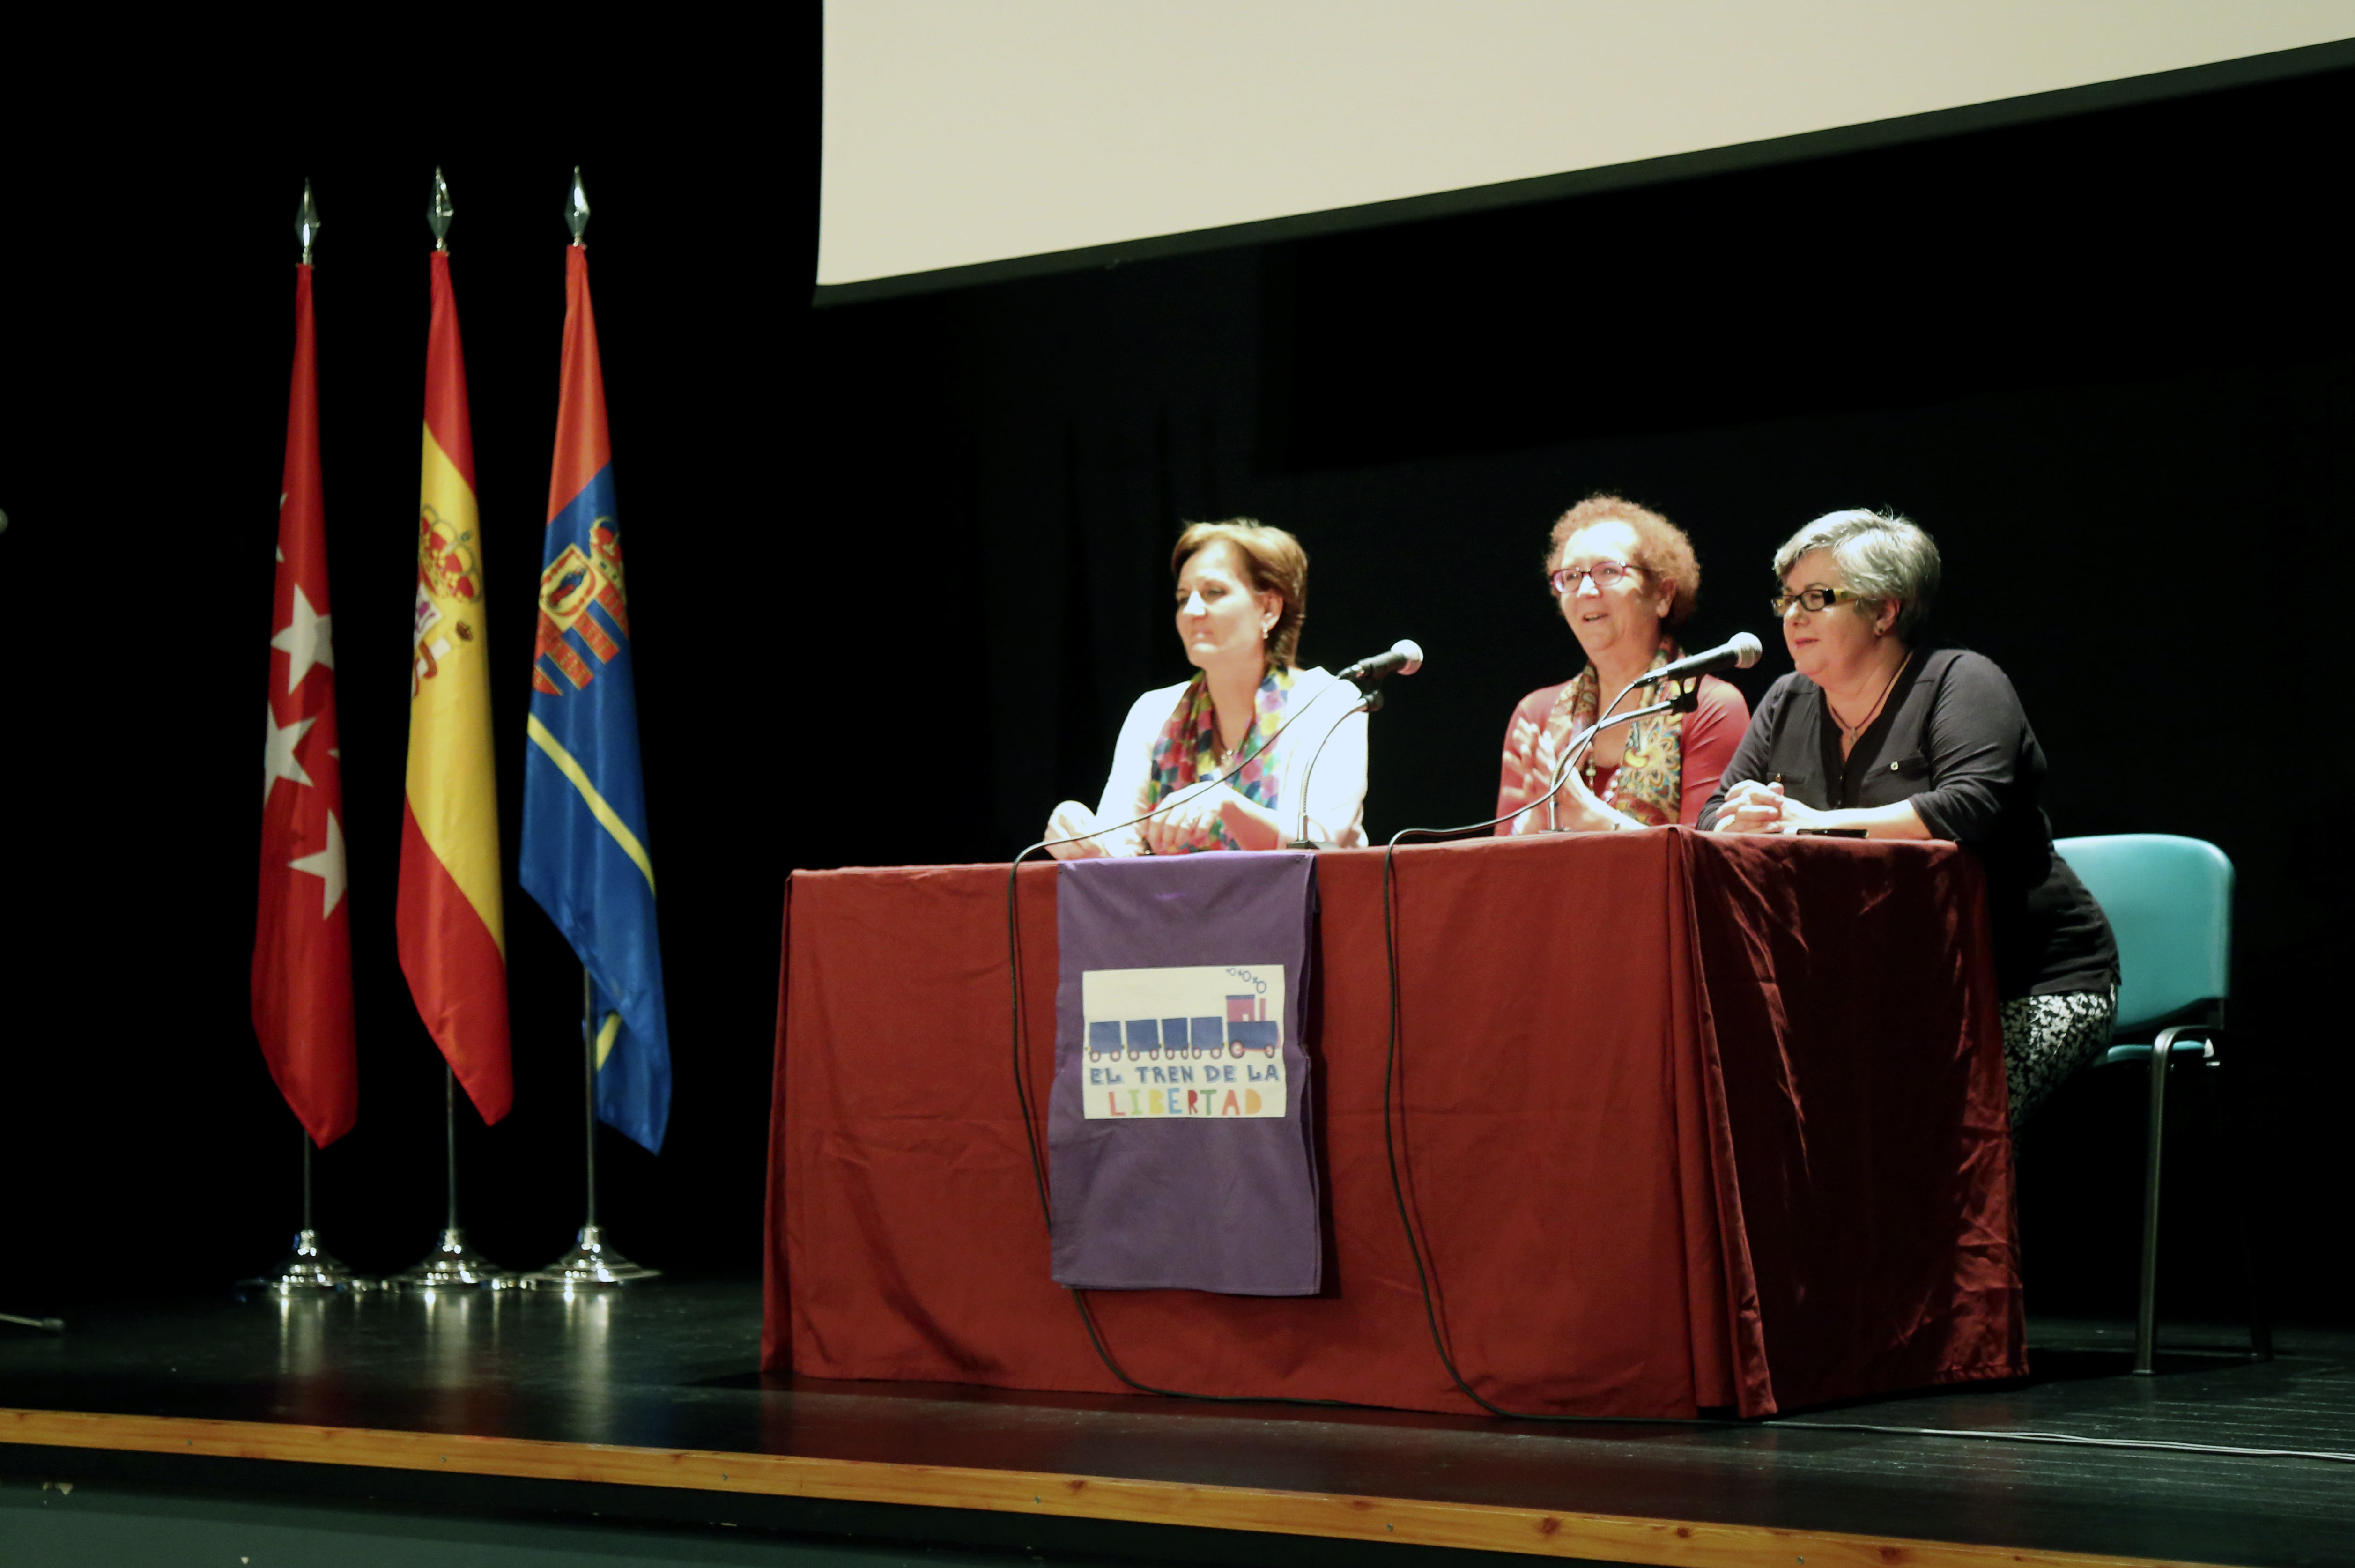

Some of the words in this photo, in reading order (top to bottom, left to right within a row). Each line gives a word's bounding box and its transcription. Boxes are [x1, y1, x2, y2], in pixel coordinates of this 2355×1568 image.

[1090, 1067, 1123, 1084] EL
[1136, 1065, 1194, 1084] TREN
[1204, 1065, 1236, 1082] DE
[1248, 1064, 1279, 1081] LA
[1109, 1088, 1262, 1116] LIBERTAD
